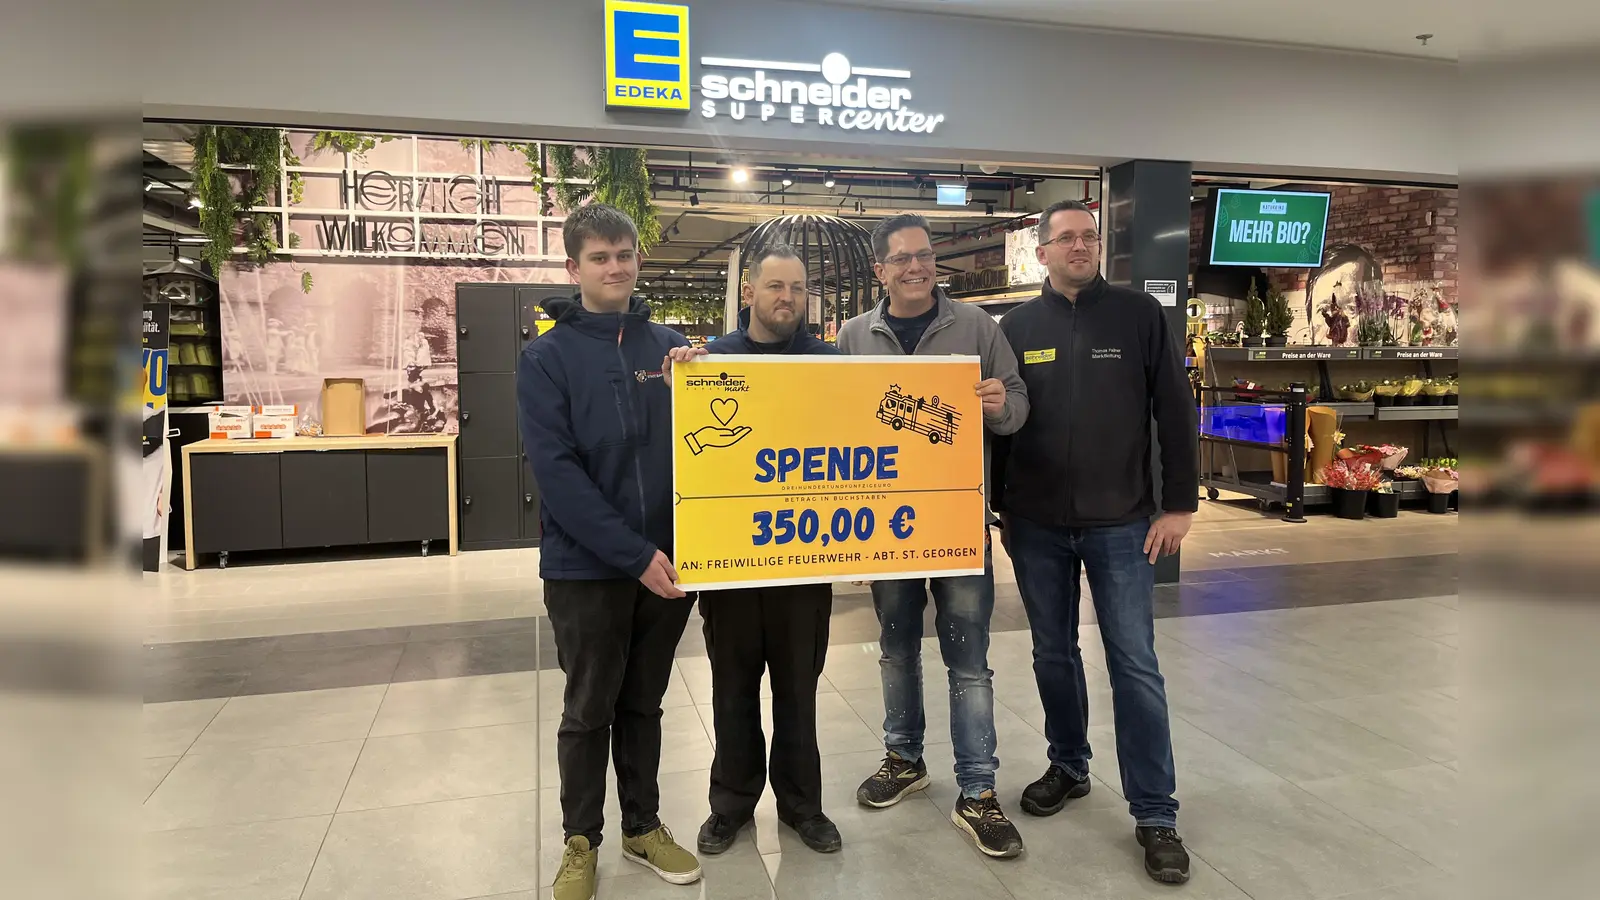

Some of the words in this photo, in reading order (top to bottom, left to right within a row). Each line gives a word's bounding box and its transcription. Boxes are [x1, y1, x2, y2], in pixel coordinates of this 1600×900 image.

[615, 85, 683, 101] EDEKA
[701, 70, 912, 110] schneider
[701, 100, 833, 126] SUPER
[838, 107, 944, 133] center
[1229, 219, 1274, 244] MEHR
[1276, 220, 1311, 245] BIO?
[686, 379, 746, 387] schneider
[724, 384, 750, 392] markt
[754, 446, 898, 482] SPENDE
[782, 483, 891, 491] DREIHUNDERTUNDFÜNFZIGEURO
[752, 507, 875, 547] 350,00
[888, 505, 916, 540] €
[681, 561, 703, 570] AN:
[707, 556, 784, 569] FREIWILLIGE
[788, 552, 862, 565] FEUERWEHR
[873, 551, 899, 561] ABT.
[903, 550, 919, 560] ST.
[923, 547, 977, 558] GEORGEN
